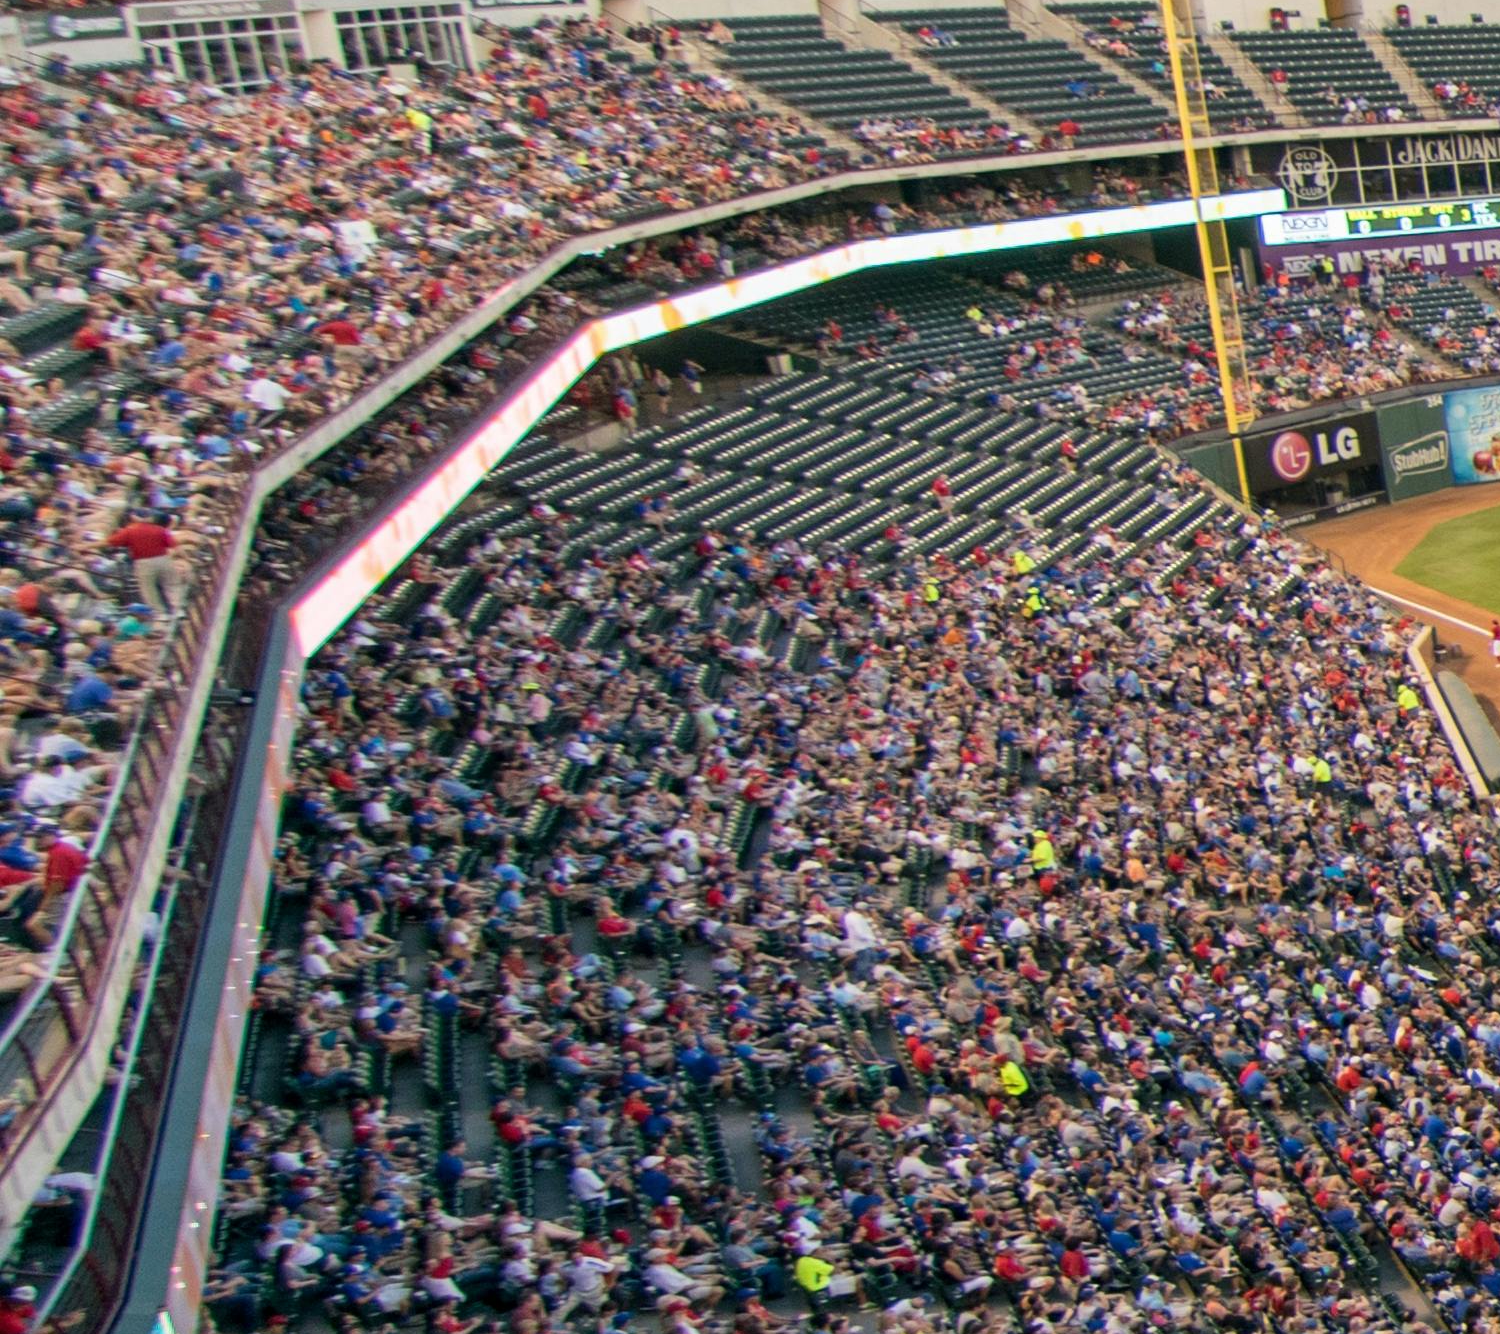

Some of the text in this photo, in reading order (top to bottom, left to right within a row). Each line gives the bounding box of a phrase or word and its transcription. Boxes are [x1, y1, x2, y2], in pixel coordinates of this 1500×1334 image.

[1295, 151, 1317, 161] OLD
[1398, 137, 1452, 164] JACK
[1301, 186, 1323, 197] CLUB
[1338, 244, 1448, 274] NEXEN
[1316, 427, 1361, 466] LG
[1394, 441, 1446, 472] StubHub!
